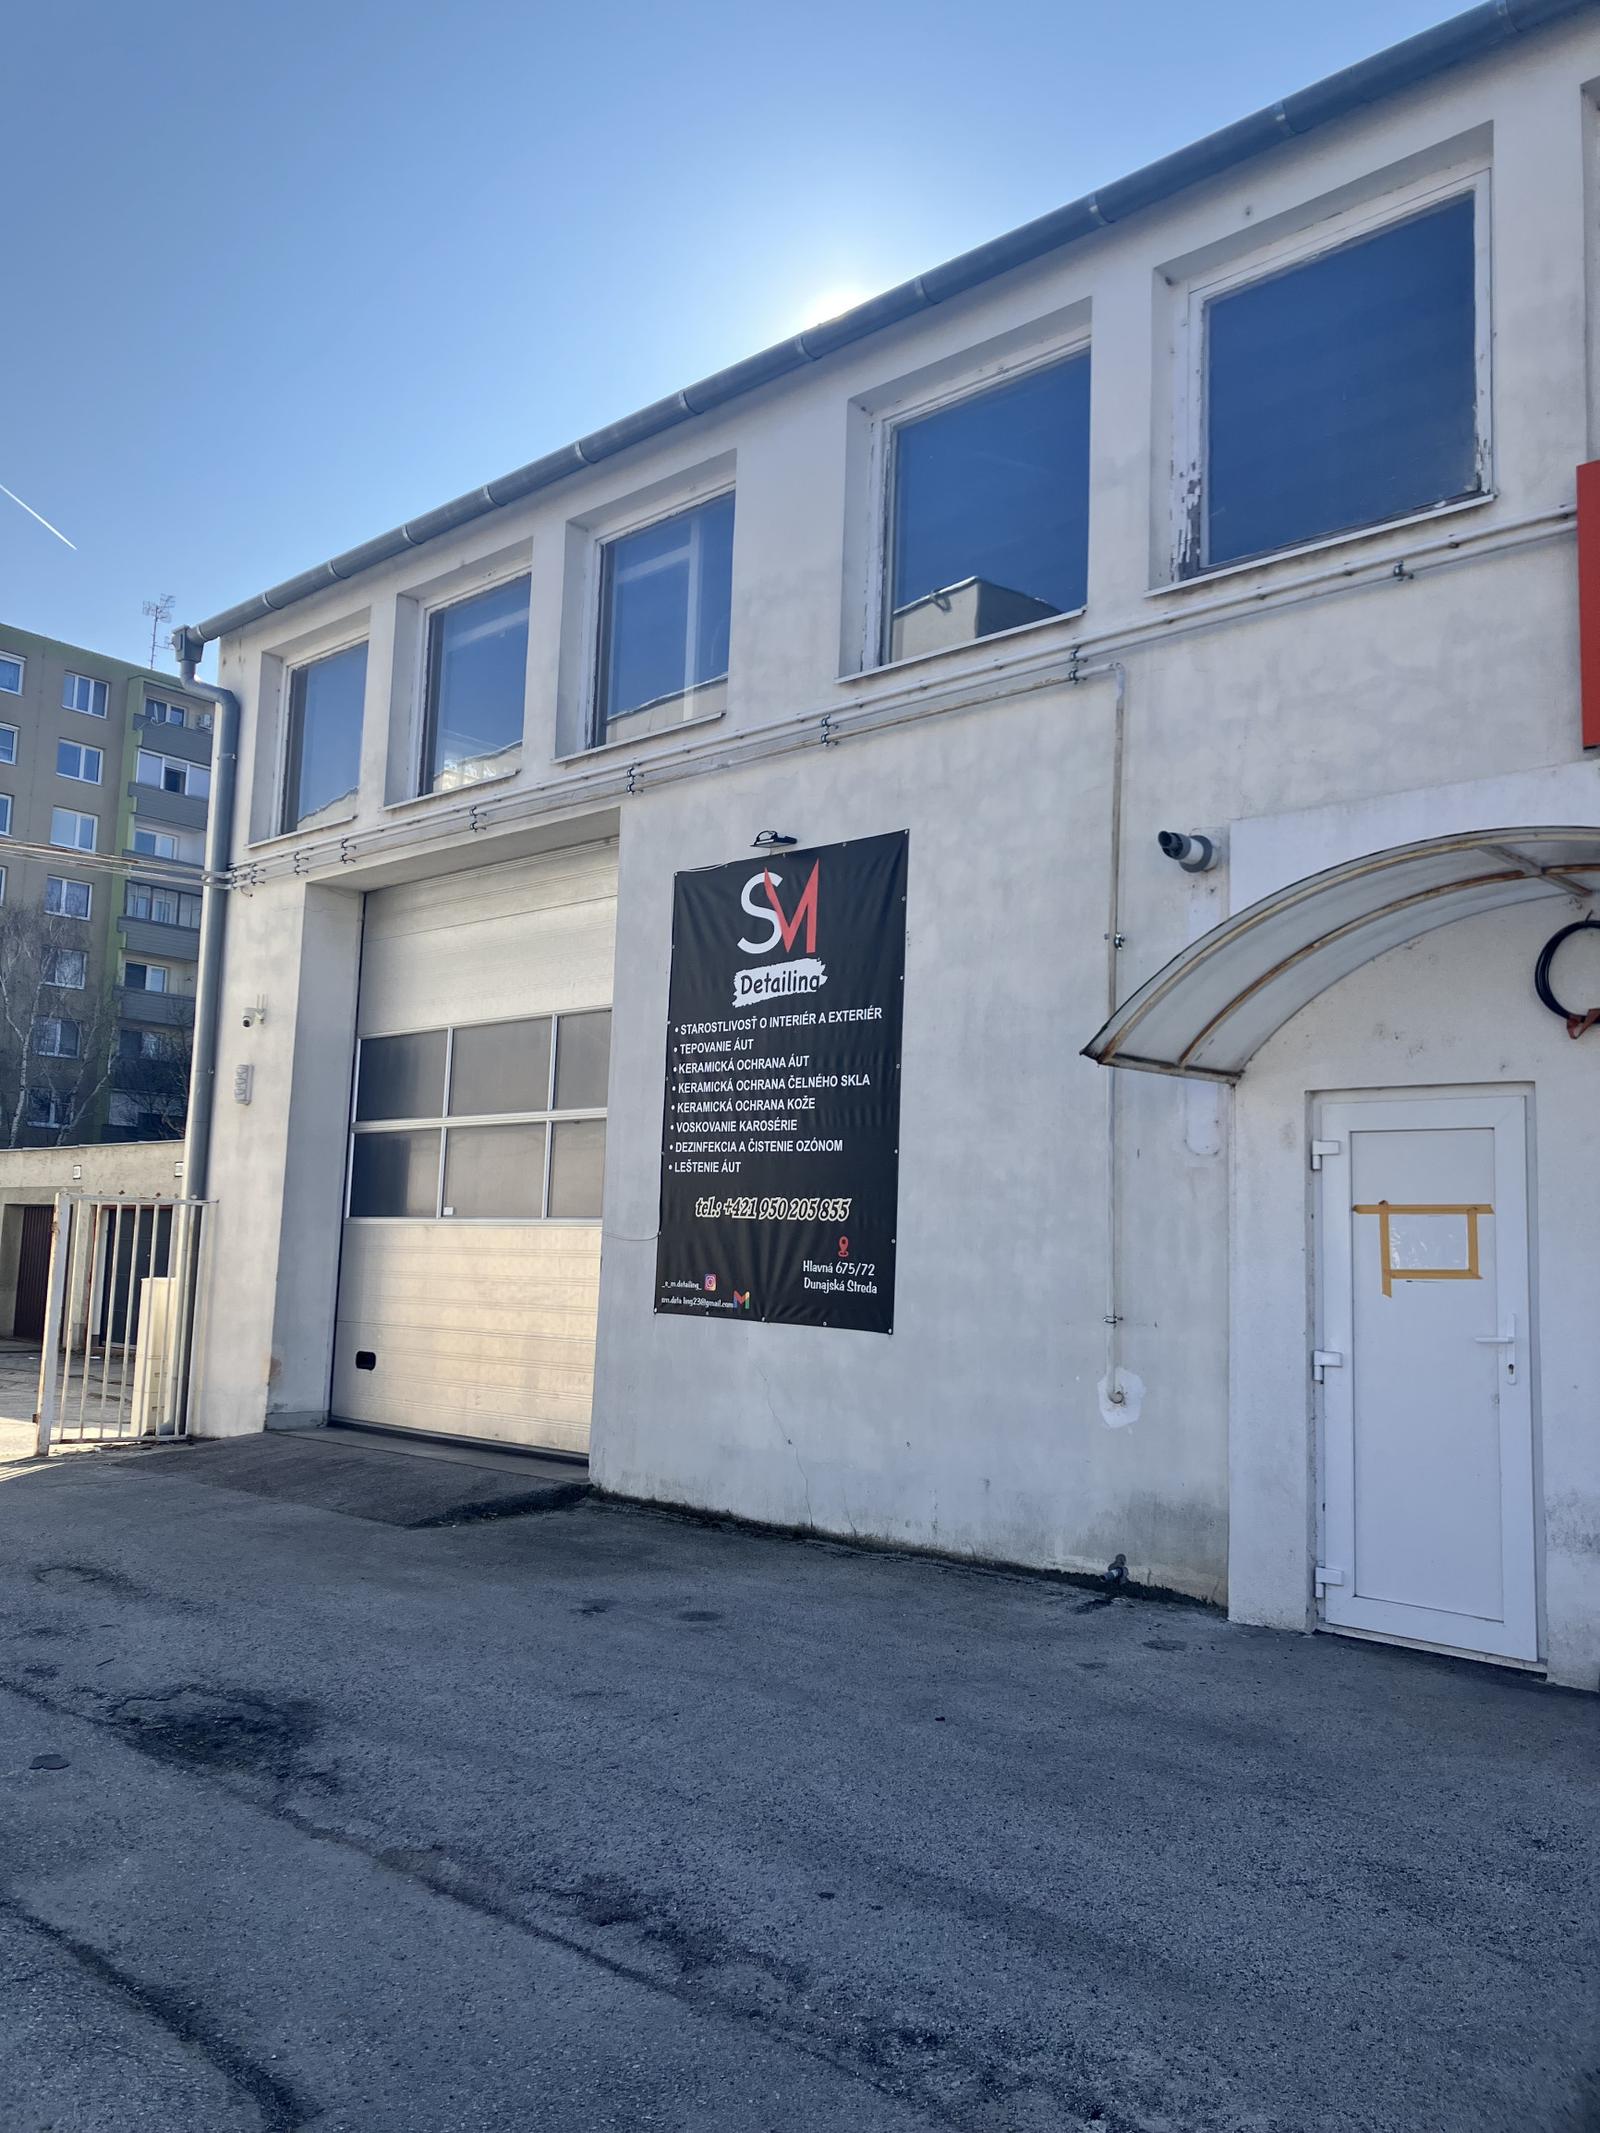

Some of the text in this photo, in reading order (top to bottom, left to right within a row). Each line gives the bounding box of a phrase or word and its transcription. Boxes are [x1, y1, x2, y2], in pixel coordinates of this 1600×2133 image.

[680, 1005, 882, 1035] STAROSTLIVOSŤ O INTERIÉR A EXTERIÉR
[680, 1037, 754, 1054] TEPOVANIE ÁUT
[678, 1054, 809, 1074] KERAMICKÁ OCHRANA ÁUT
[678, 1074, 870, 1093] KERAMICKÁ OCHRANA ČELNÉHO SKLA
[677, 1095, 815, 1113] KERAMICKÁ OCHRANA KOŽE
[676, 1117, 797, 1132] VOSKOVANIE KAROSÉRIE
[675, 1138, 843, 1152] DEZINFEKCIA A ČISTENIE OZÓNOM
[674, 1157, 741, 1173] LEŠTENIE ÁUT
[695, 1195, 852, 1222] tel.: +421 950 205 855
[803, 1260, 875, 1276] Hlavná 675/72
[804, 1277, 878, 1294] Dunajská Streda
